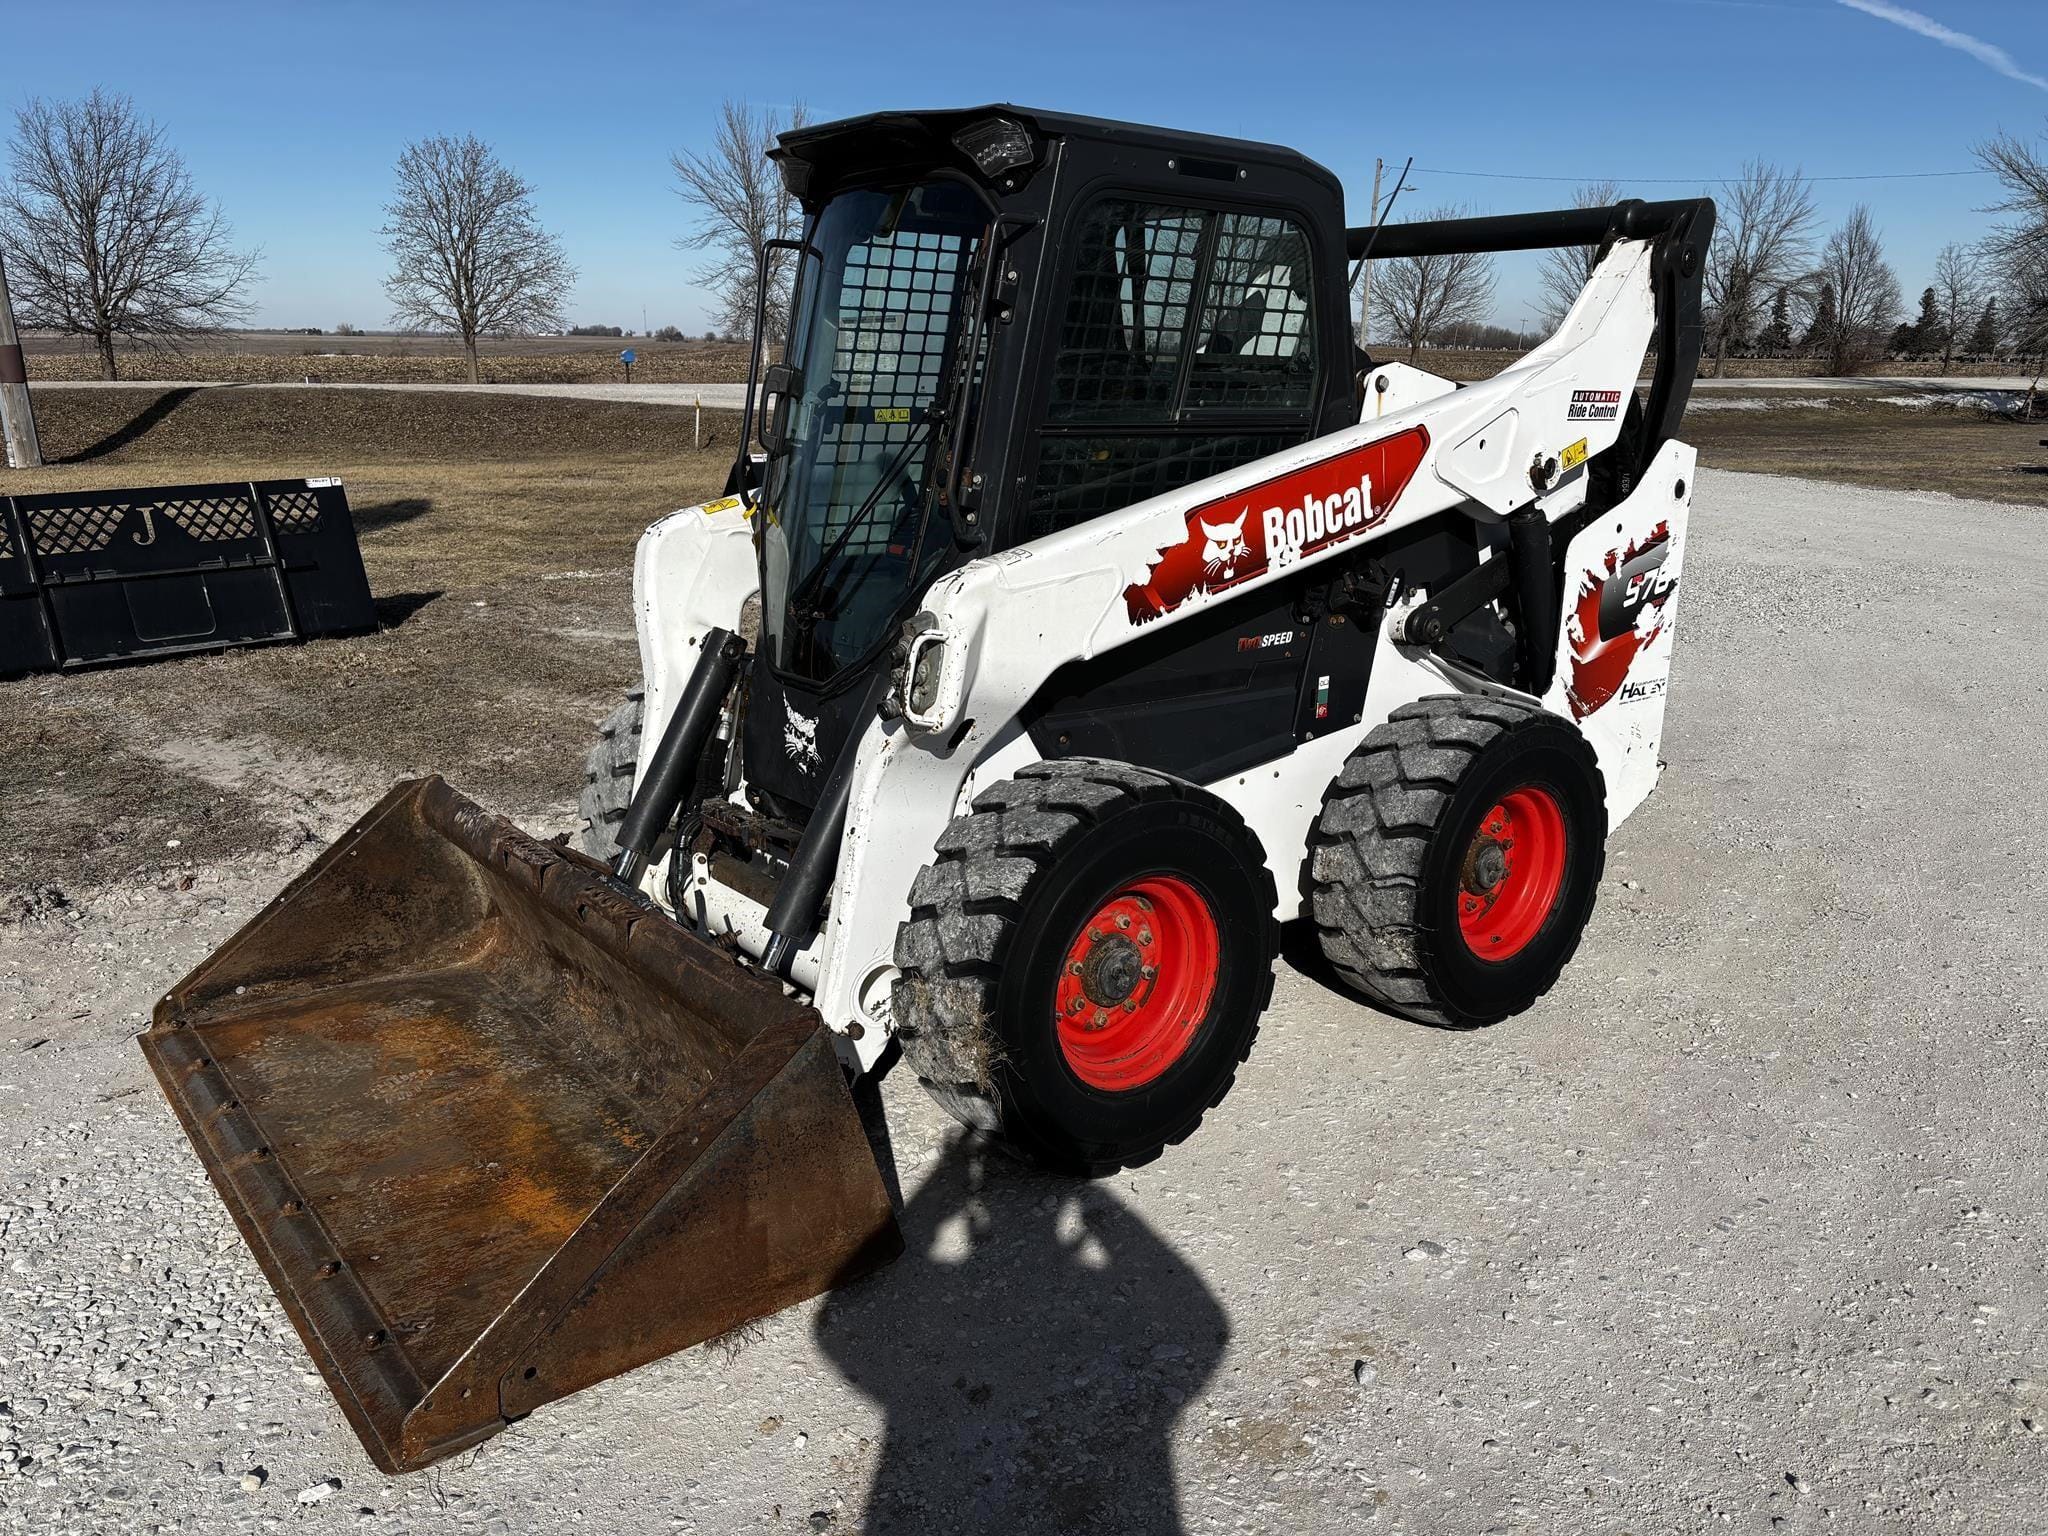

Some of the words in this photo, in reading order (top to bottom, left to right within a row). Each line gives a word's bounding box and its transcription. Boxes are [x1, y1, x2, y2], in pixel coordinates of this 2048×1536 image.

[1573, 391, 1620, 402] AUTOMATIC
[1568, 404, 1587, 418] Ride
[1588, 404, 1618, 418] Control
[1262, 473, 1375, 562] Bobcat
[1261, 631, 1294, 648] SPEED
